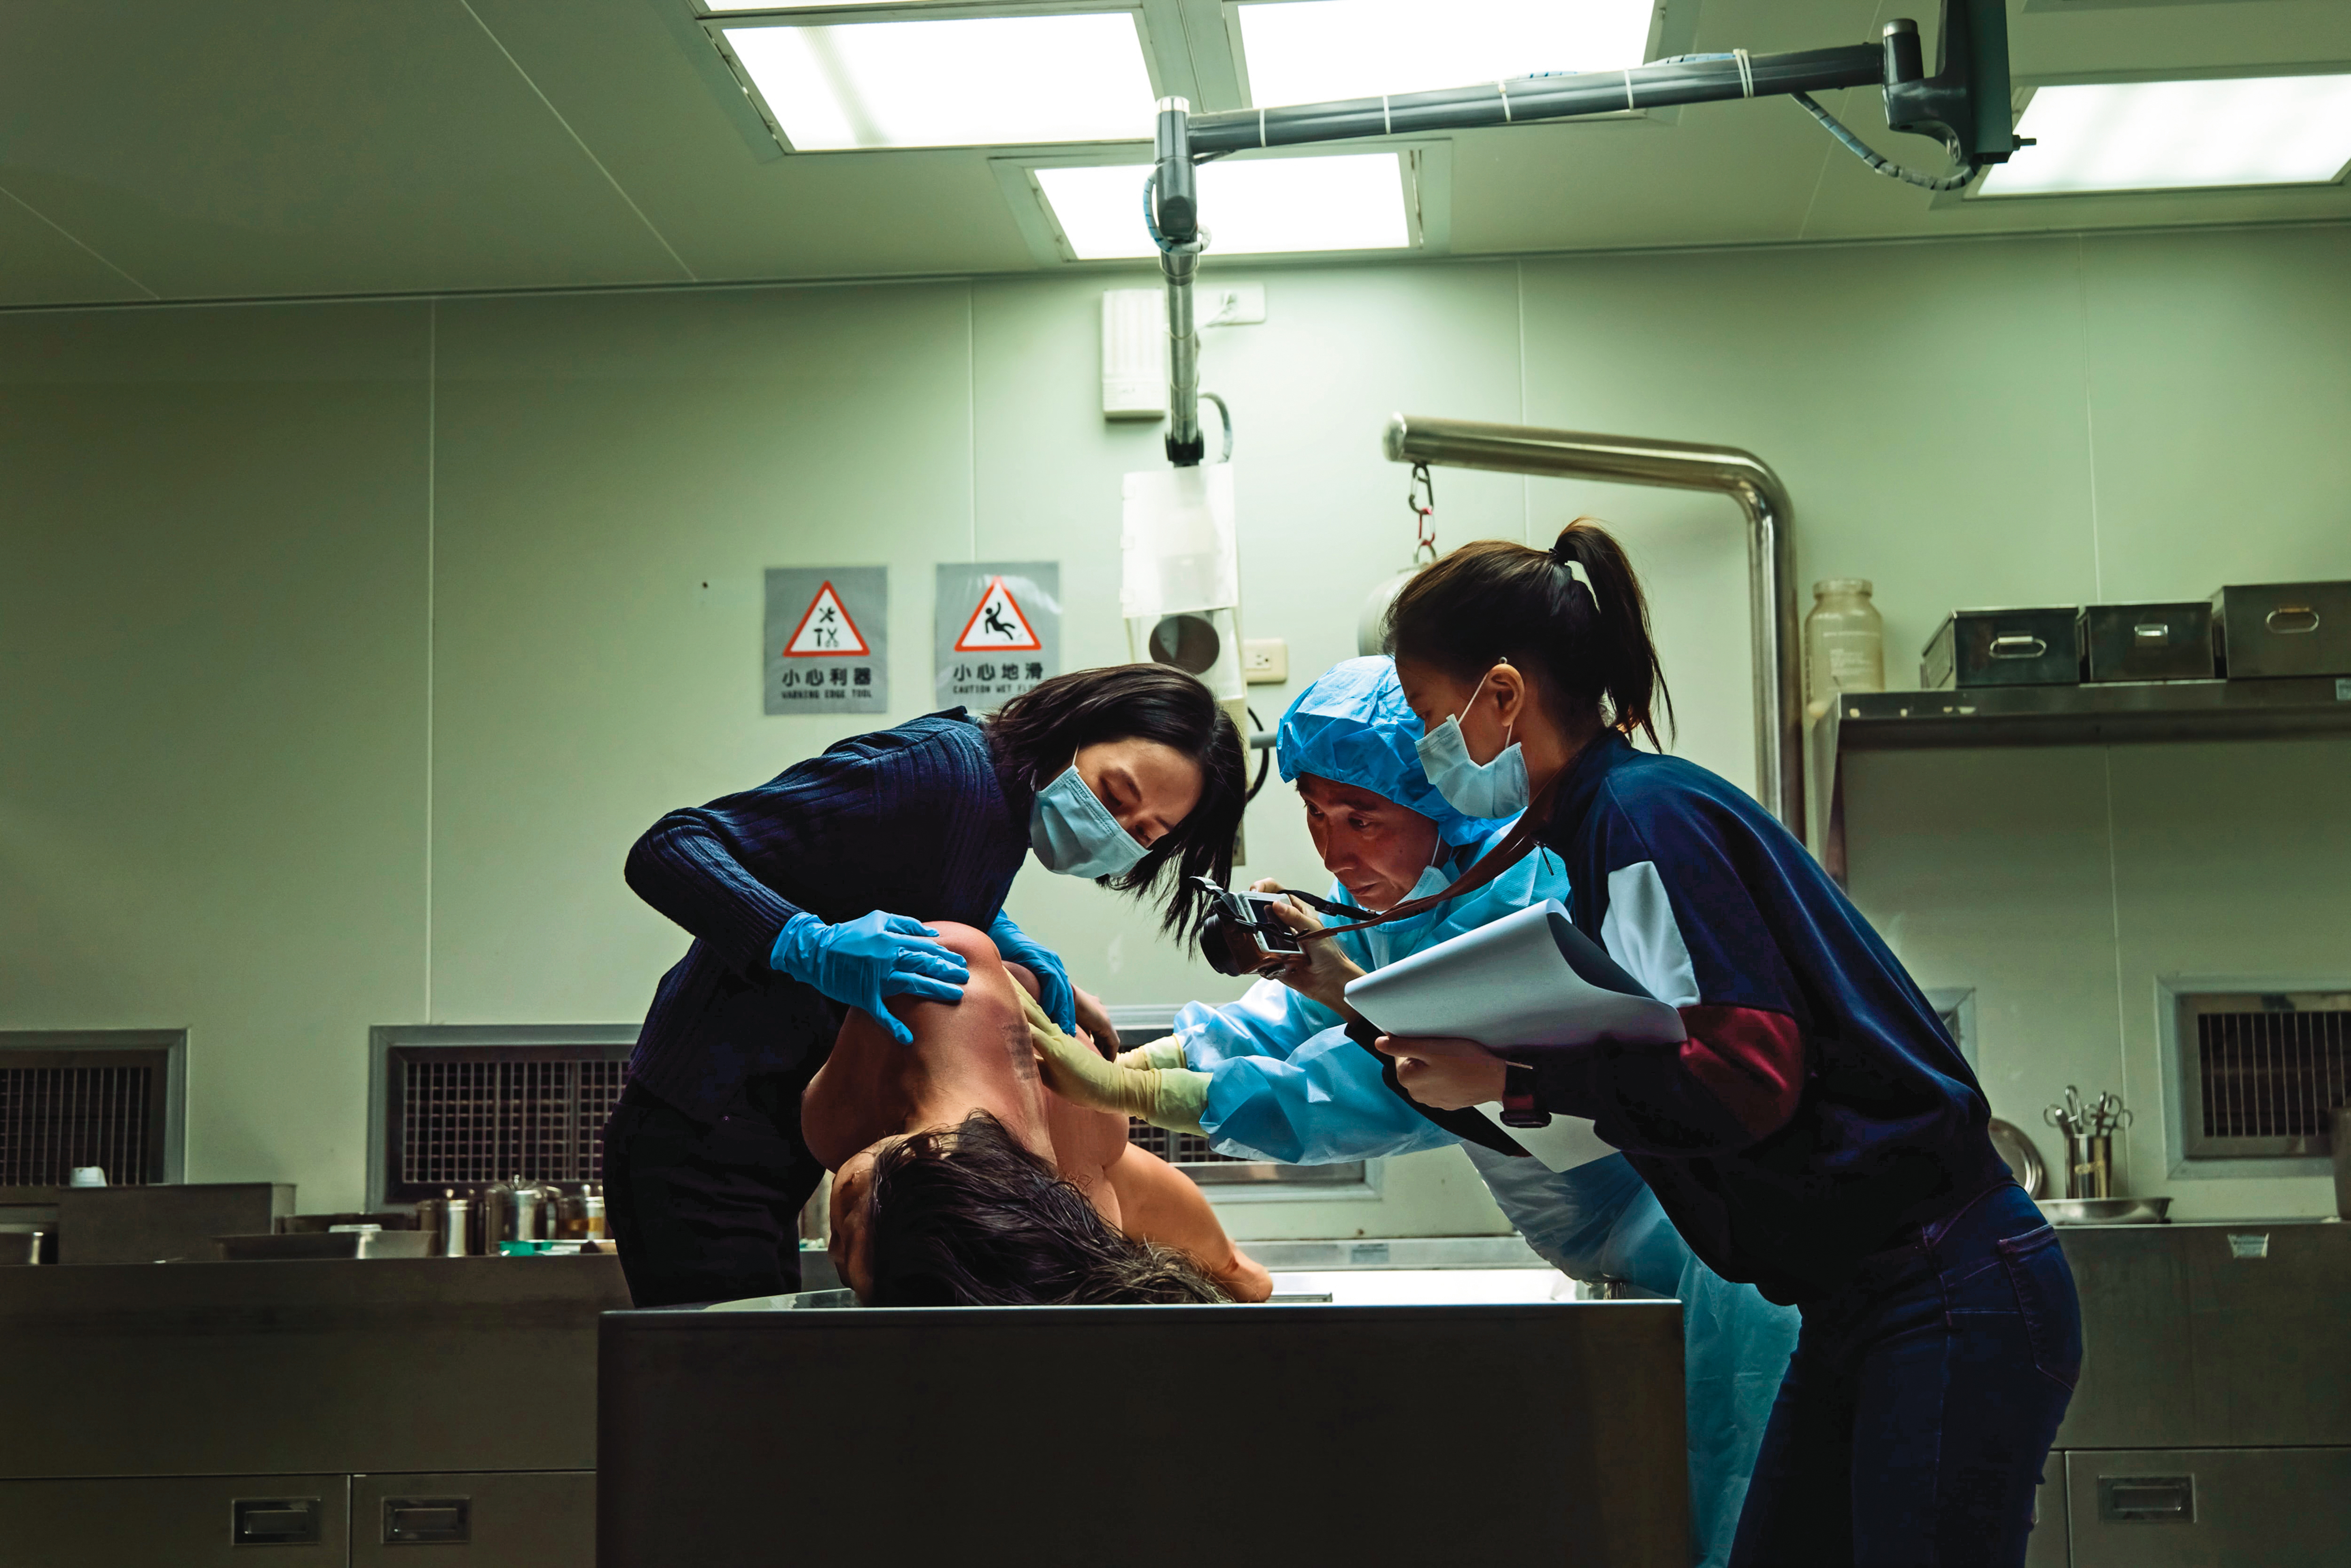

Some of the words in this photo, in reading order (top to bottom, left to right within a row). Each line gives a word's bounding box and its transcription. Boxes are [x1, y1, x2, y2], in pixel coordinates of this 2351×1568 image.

[782, 667, 870, 687] 小心利器
[954, 662, 1042, 682] 小心地滑
[953, 685, 991, 694] CAUTION
